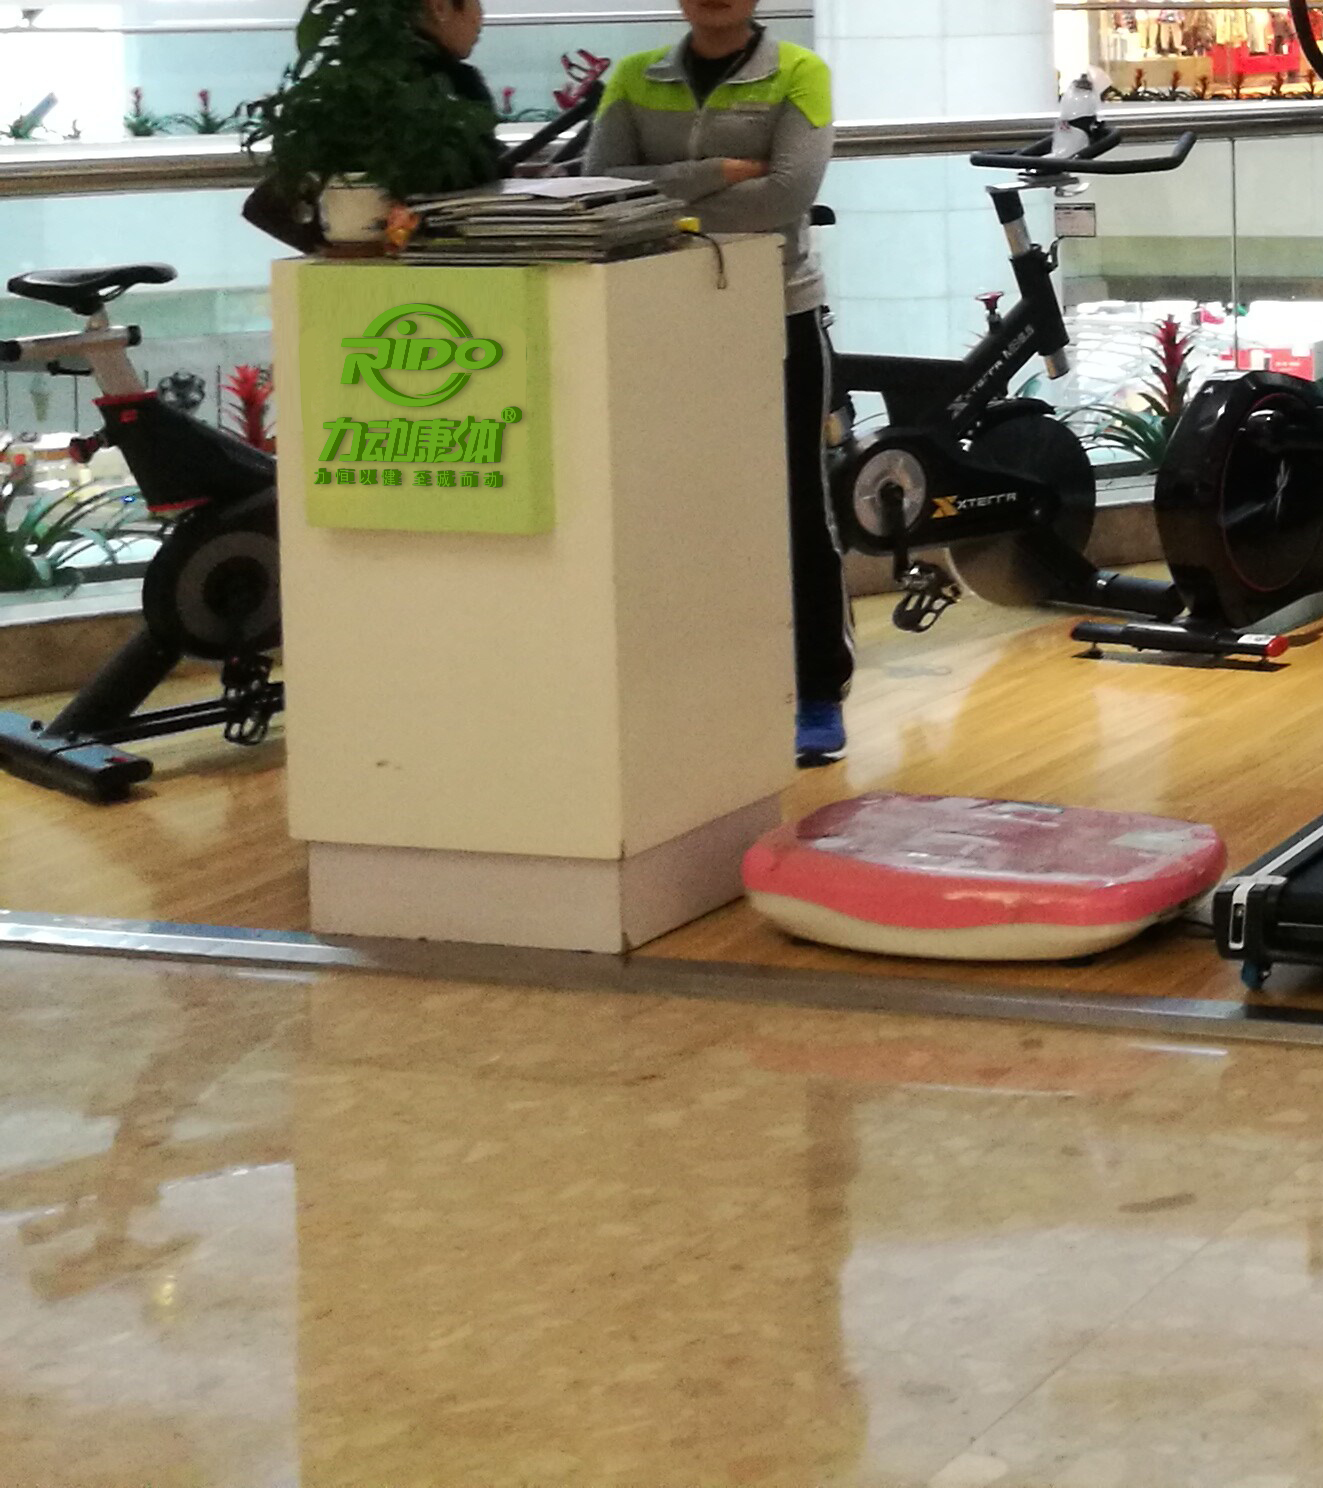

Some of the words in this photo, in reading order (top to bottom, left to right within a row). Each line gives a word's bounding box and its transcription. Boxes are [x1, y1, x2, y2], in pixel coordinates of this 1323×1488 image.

[317, 416, 506, 463] 力动康体
[411, 470, 504, 488] 至诚而动
